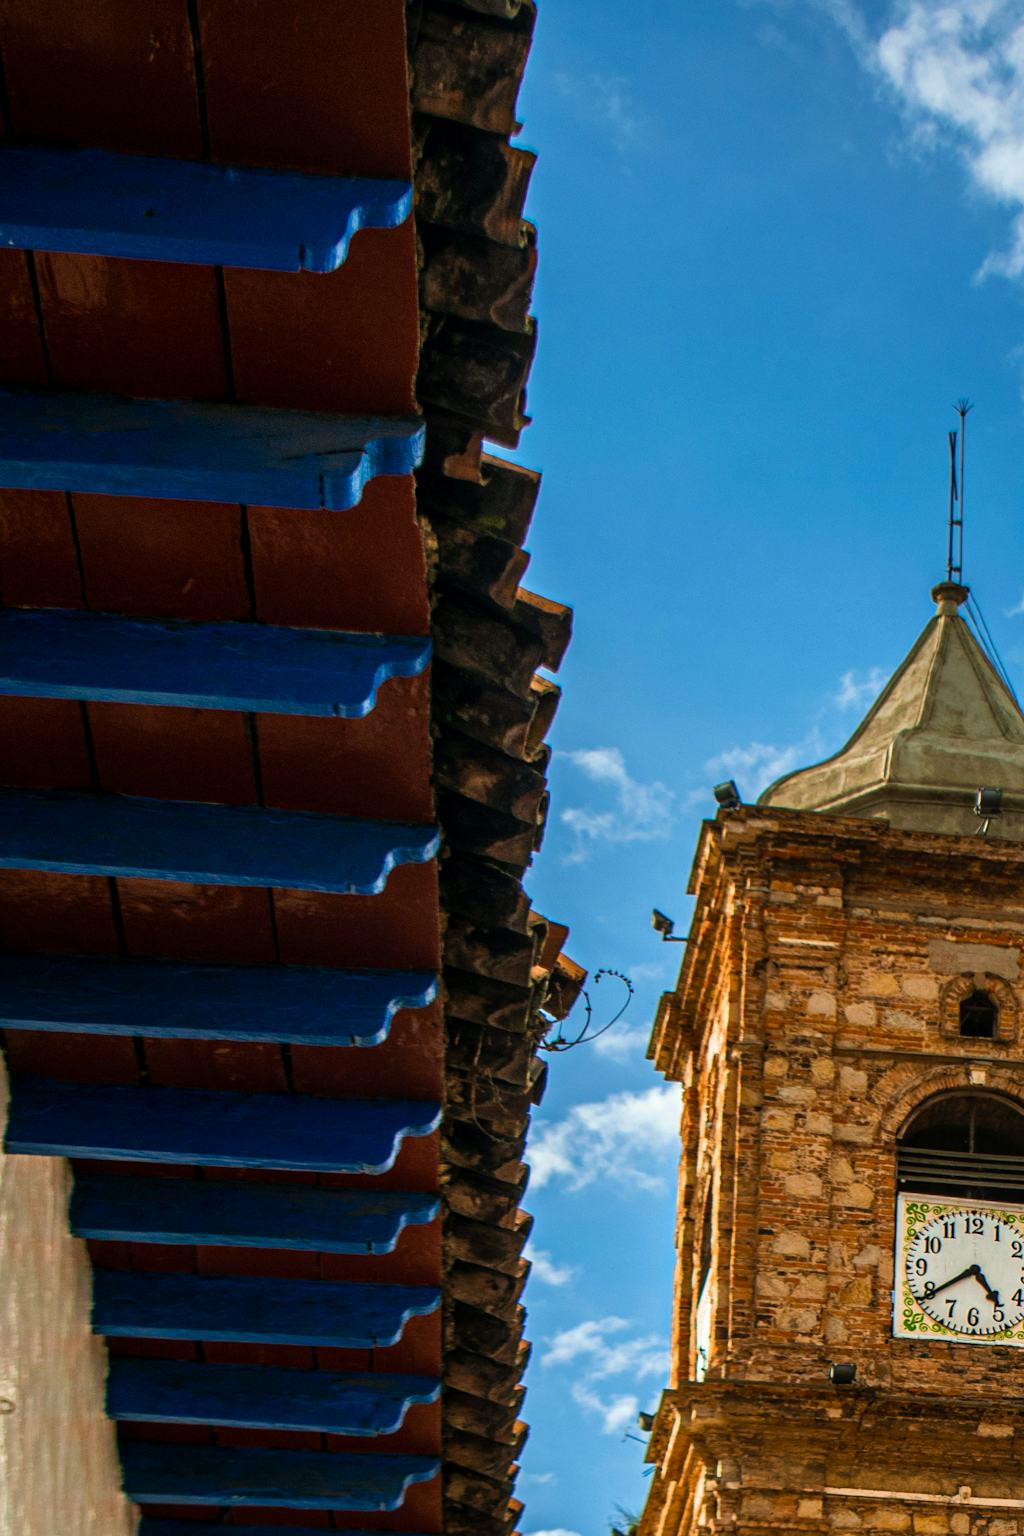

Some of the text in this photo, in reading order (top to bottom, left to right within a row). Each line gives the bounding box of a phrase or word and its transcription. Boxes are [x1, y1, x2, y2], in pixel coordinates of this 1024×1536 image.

[943, 1222, 956, 1238] 11
[964, 1218, 984, 1235] 12
[994, 1225, 1000, 1242] 1
[924, 1236, 941, 1254] 10
[1011, 1241, 1023, 1259] 2
[916, 1258, 927, 1276] 9
[924, 1282, 936, 1299] 8
[1012, 1289, 1024, 1306] 4
[945, 1299, 957, 1317] 7
[967, 1307, 979, 1326] 6
[993, 1302, 1004, 1322] 5
